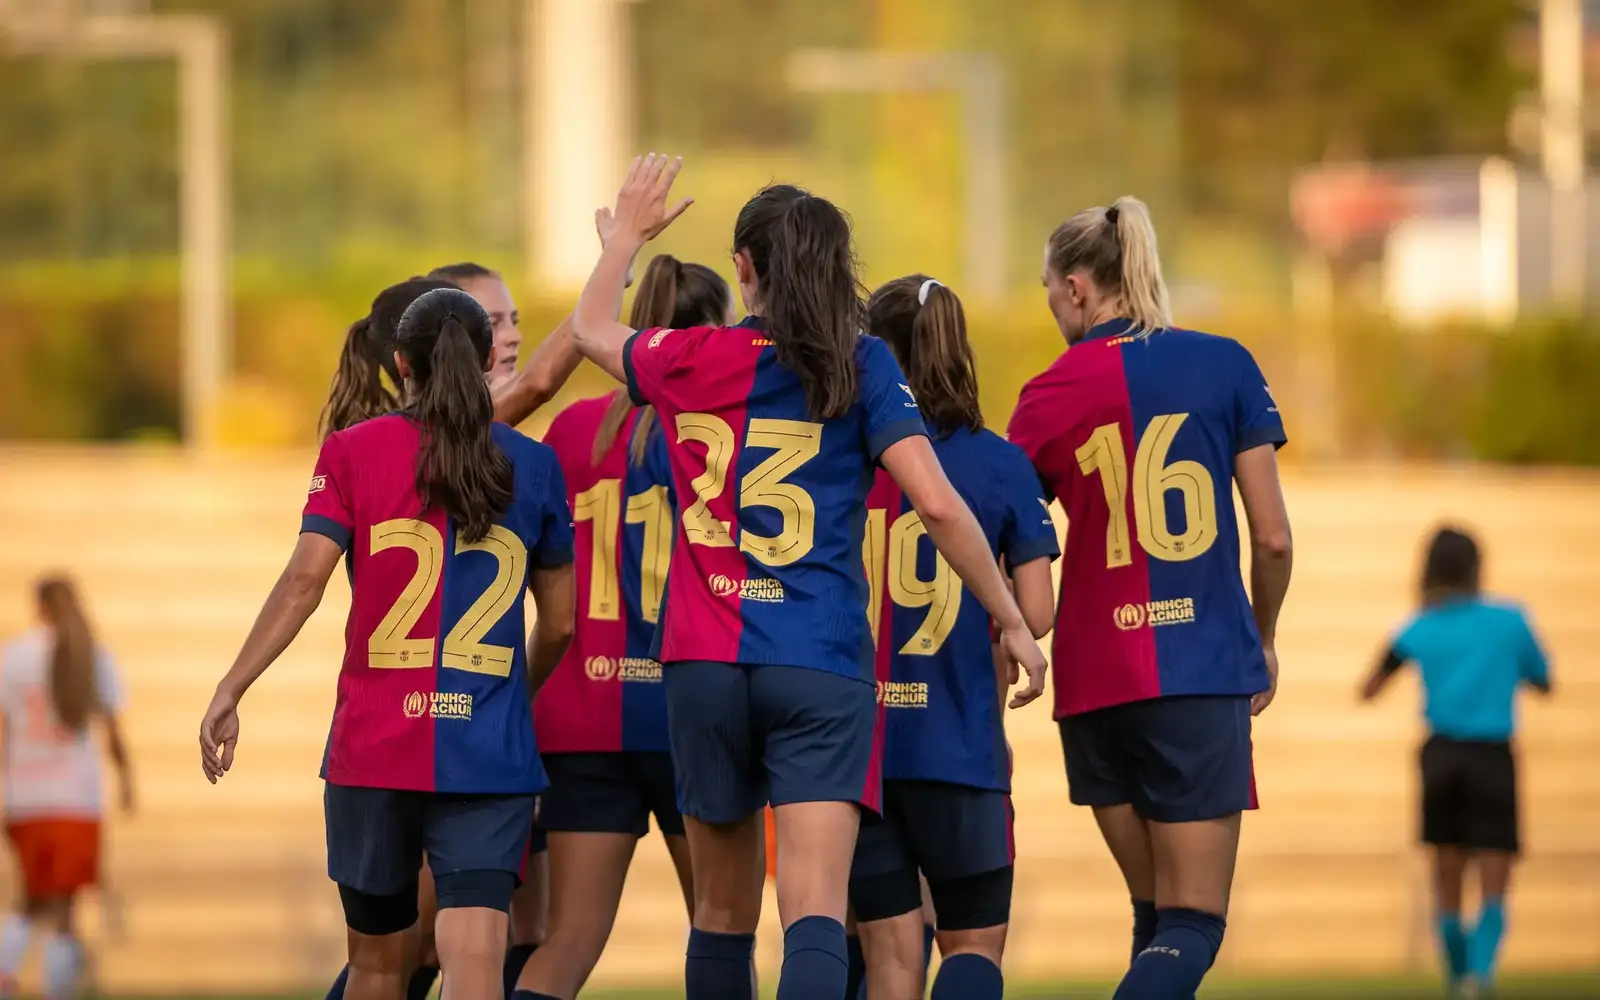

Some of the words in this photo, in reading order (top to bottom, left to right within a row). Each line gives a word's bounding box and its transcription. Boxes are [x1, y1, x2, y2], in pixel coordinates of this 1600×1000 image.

[675, 412, 824, 567] 23
[1075, 412, 1218, 569] 16
[575, 478, 674, 624] 11
[740, 578, 783, 589] UNHCR
[368, 518, 527, 677] 22
[738, 588, 784, 599] ACNUR
[1146, 597, 1194, 612] UNHCR
[1148, 607, 1195, 622] ACNUR
[618, 667, 663, 678] ACNUR
[884, 681, 928, 693] UNHCR
[429, 692, 473, 706] UNHCR
[884, 692, 928, 703] ACNUR
[429, 703, 472, 717] ACNUR
